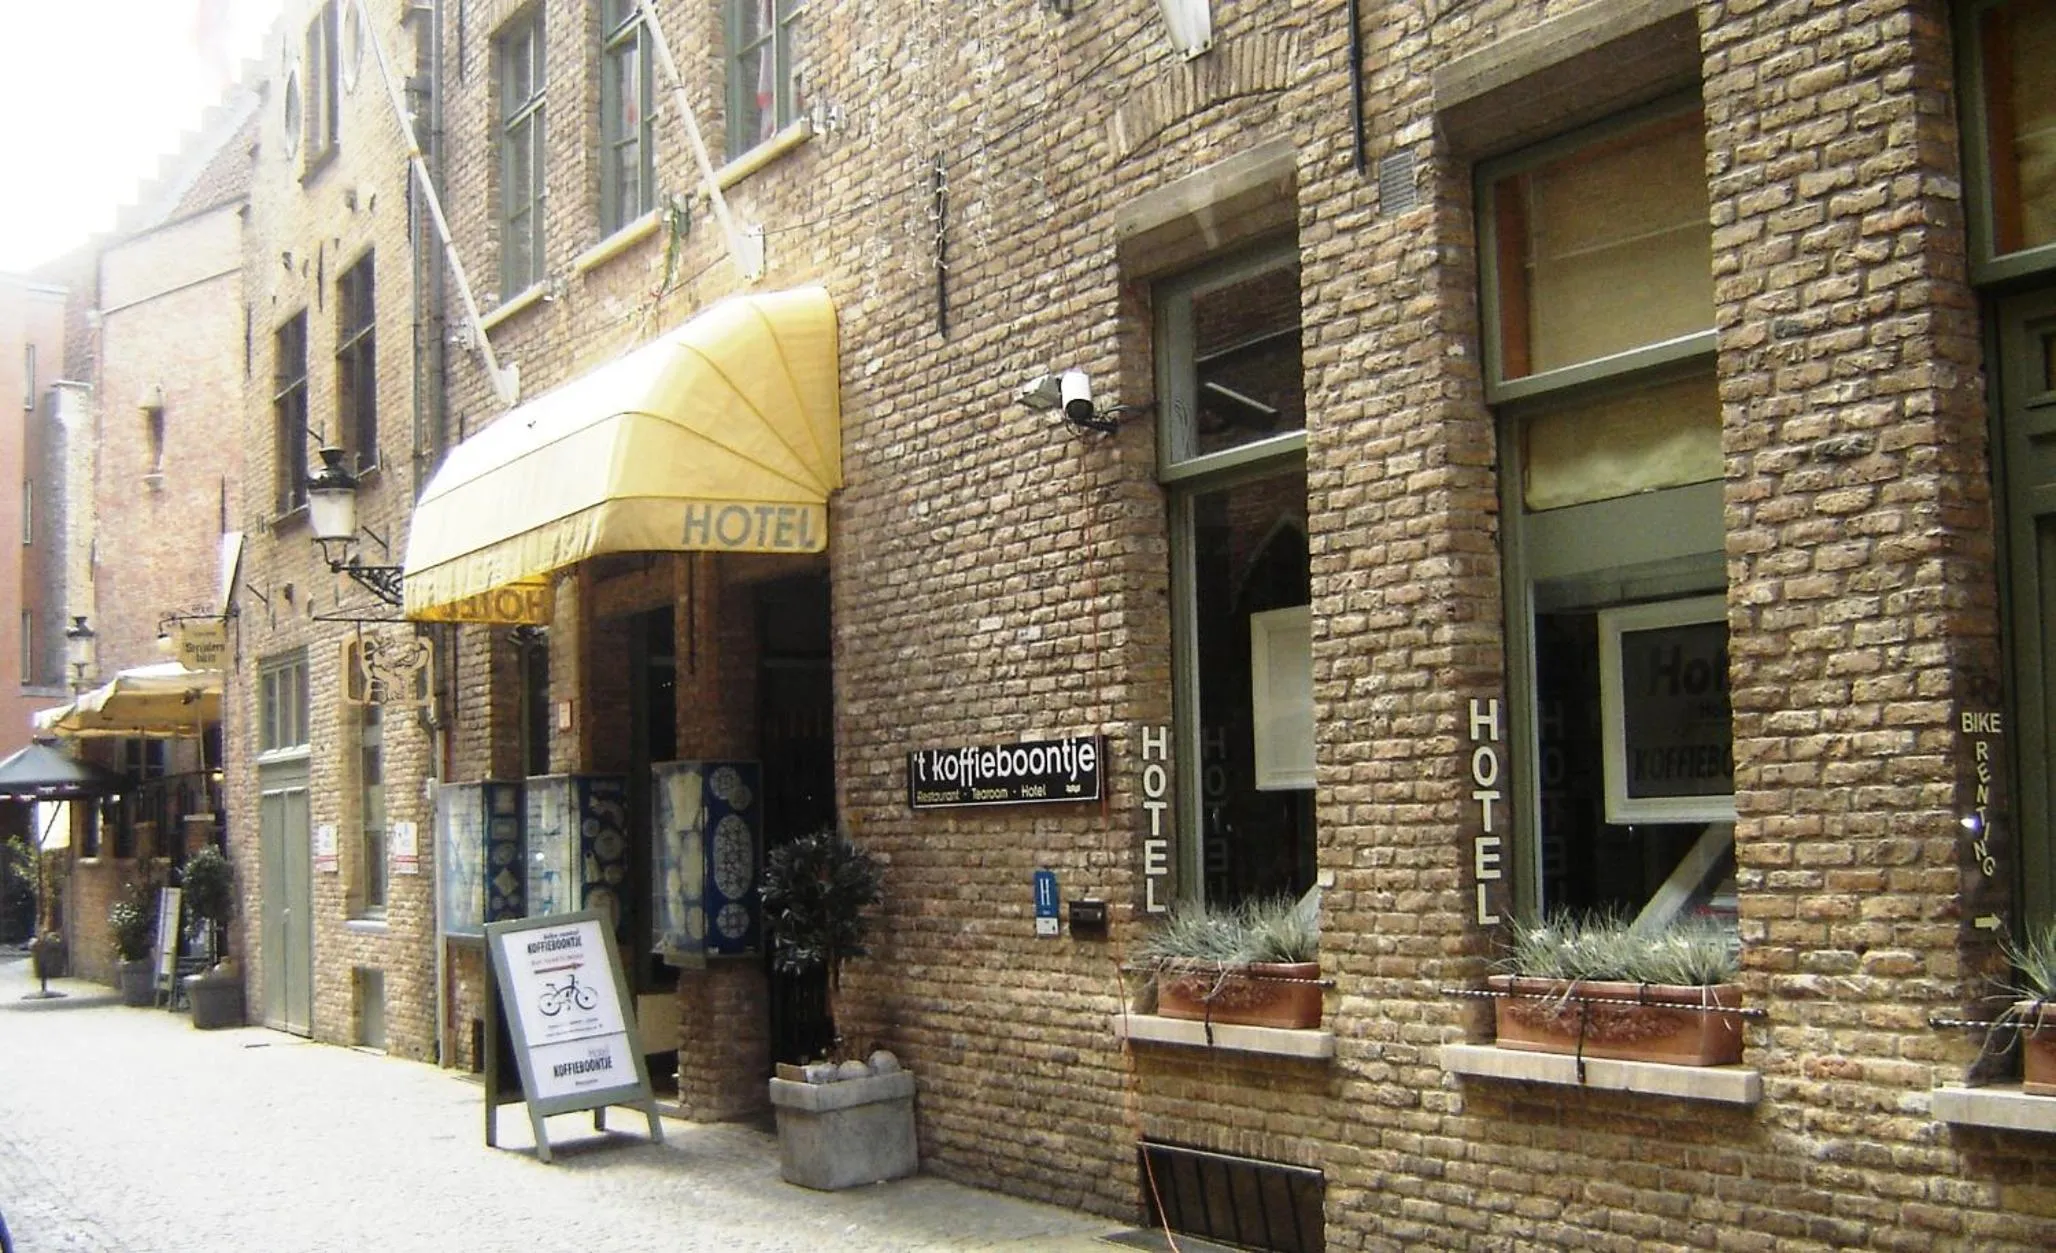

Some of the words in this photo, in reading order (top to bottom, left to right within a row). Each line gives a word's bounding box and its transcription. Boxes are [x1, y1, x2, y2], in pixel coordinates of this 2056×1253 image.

[682, 504, 817, 548] HOTEL
[1961, 712, 2002, 733] BIKE
[931, 738, 1097, 786] koffieboontje
[917, 790, 960, 802] Restaurant
[972, 787, 1008, 800] Tearoom
[1021, 784, 1046, 798] Hotel
[1470, 699, 1500, 925] HOTEL
[1973, 741, 1996, 877] RENTING
[1142, 726, 1168, 913] HOTEL
[1040, 878, 1051, 906] H
